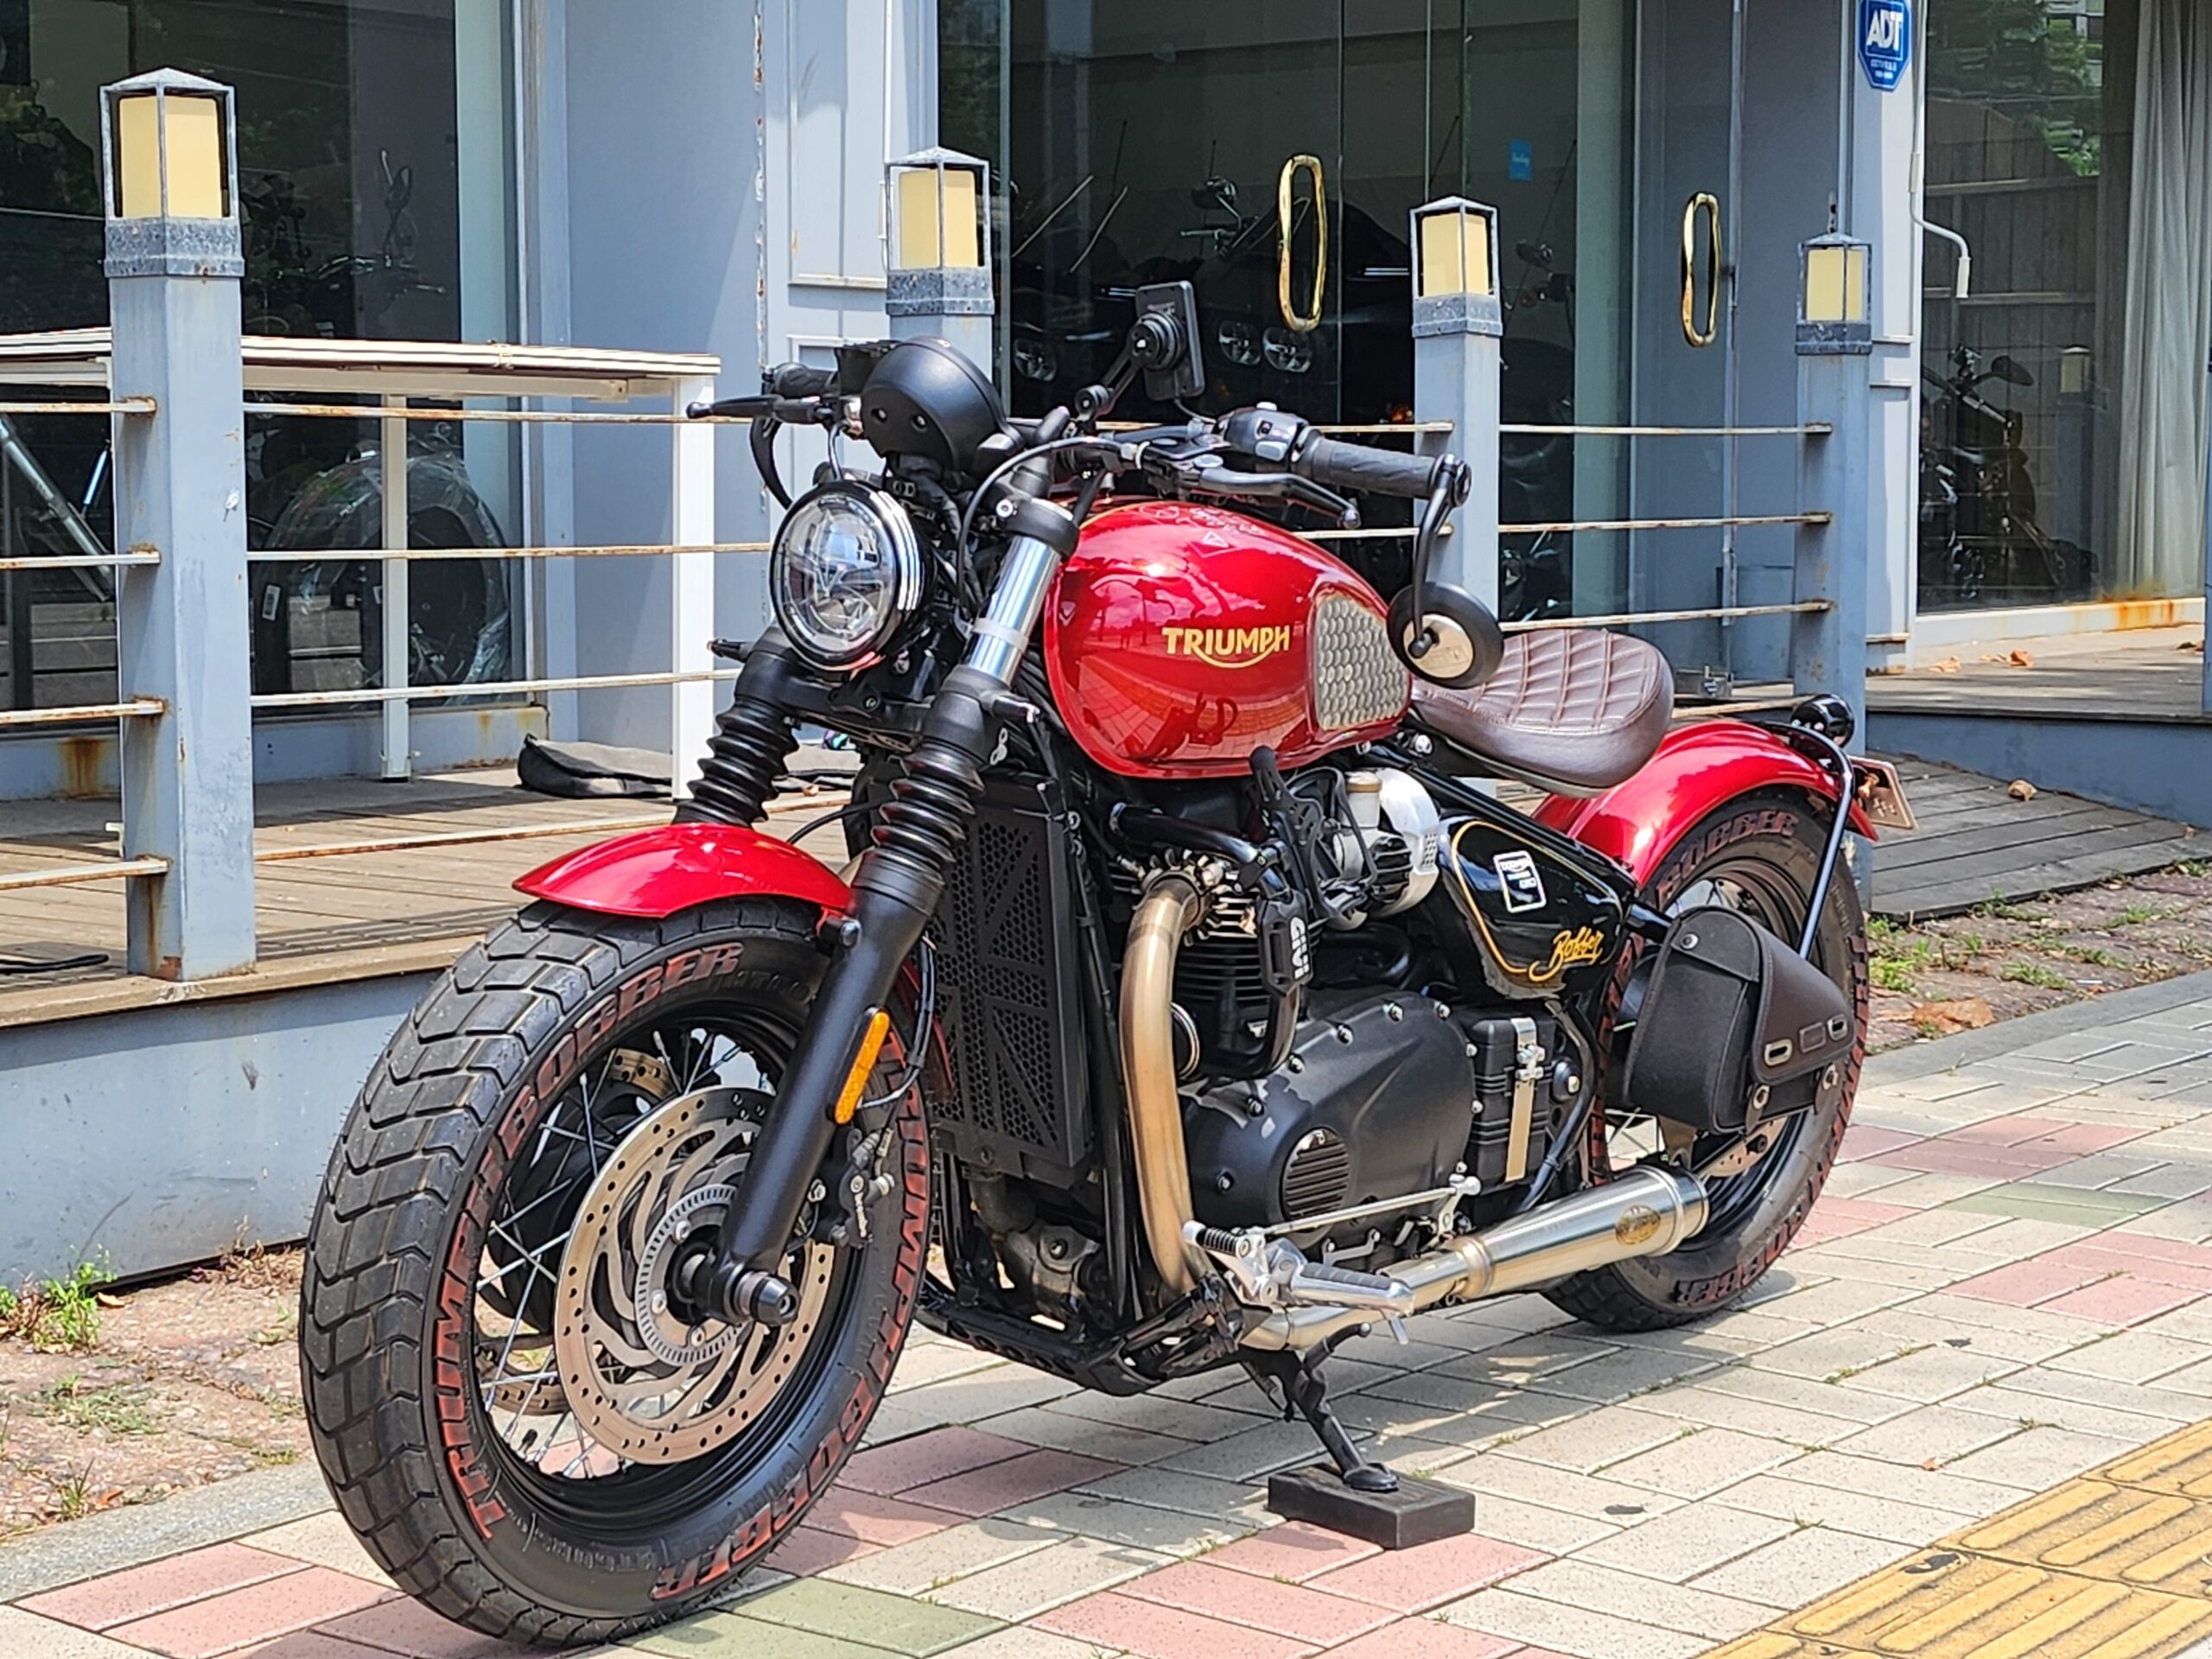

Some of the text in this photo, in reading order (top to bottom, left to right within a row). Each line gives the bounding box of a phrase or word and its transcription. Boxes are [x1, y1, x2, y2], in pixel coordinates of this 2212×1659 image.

[1866, 8, 1904, 51] ADT
[1161, 625, 1291, 669] TRIUMPH
[1655, 810, 1800, 913] BOBBER
[1528, 925, 1605, 982] Bobber
[436, 941, 745, 1540] TRIUMPH BOBBER
[650, 1372, 875, 1601] BOBBER
